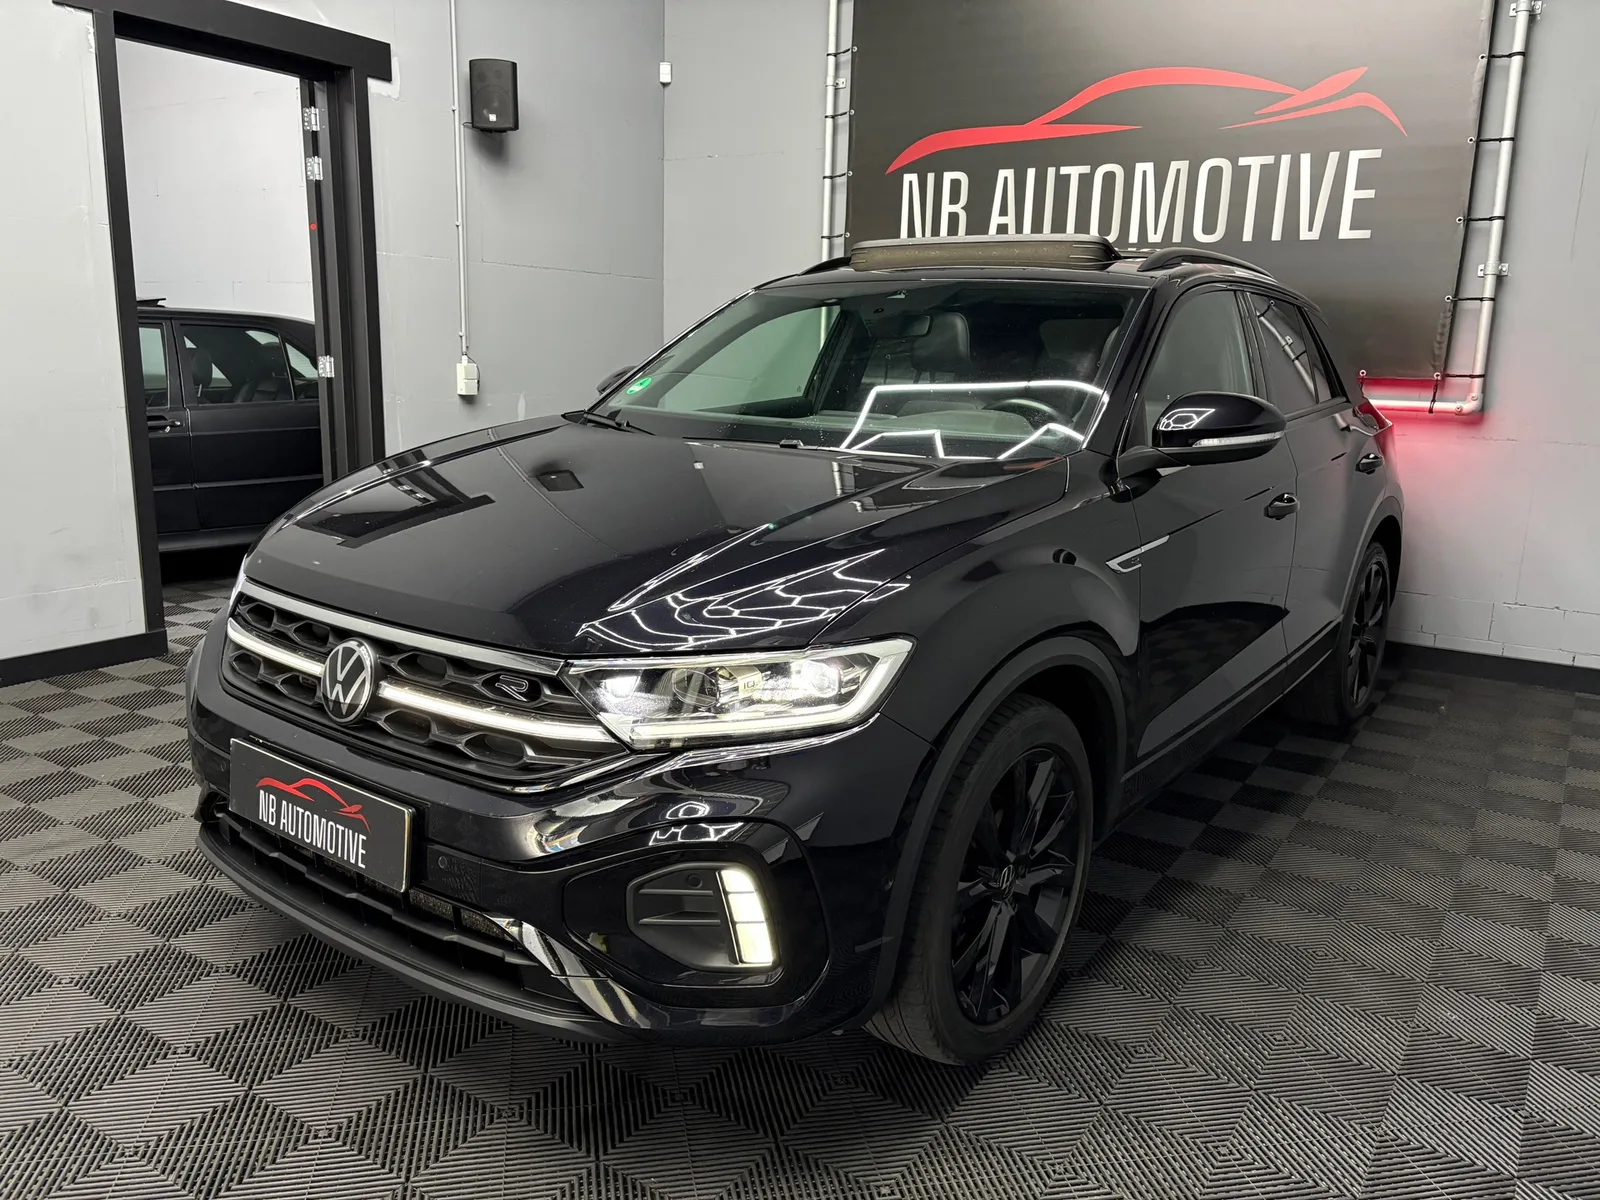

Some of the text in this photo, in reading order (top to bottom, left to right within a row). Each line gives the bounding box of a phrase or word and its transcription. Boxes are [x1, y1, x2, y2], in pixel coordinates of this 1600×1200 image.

[988, 149, 1383, 243] AUTOMOTIVE
[258, 789, 367, 869] NB AUTOMOTIVE
